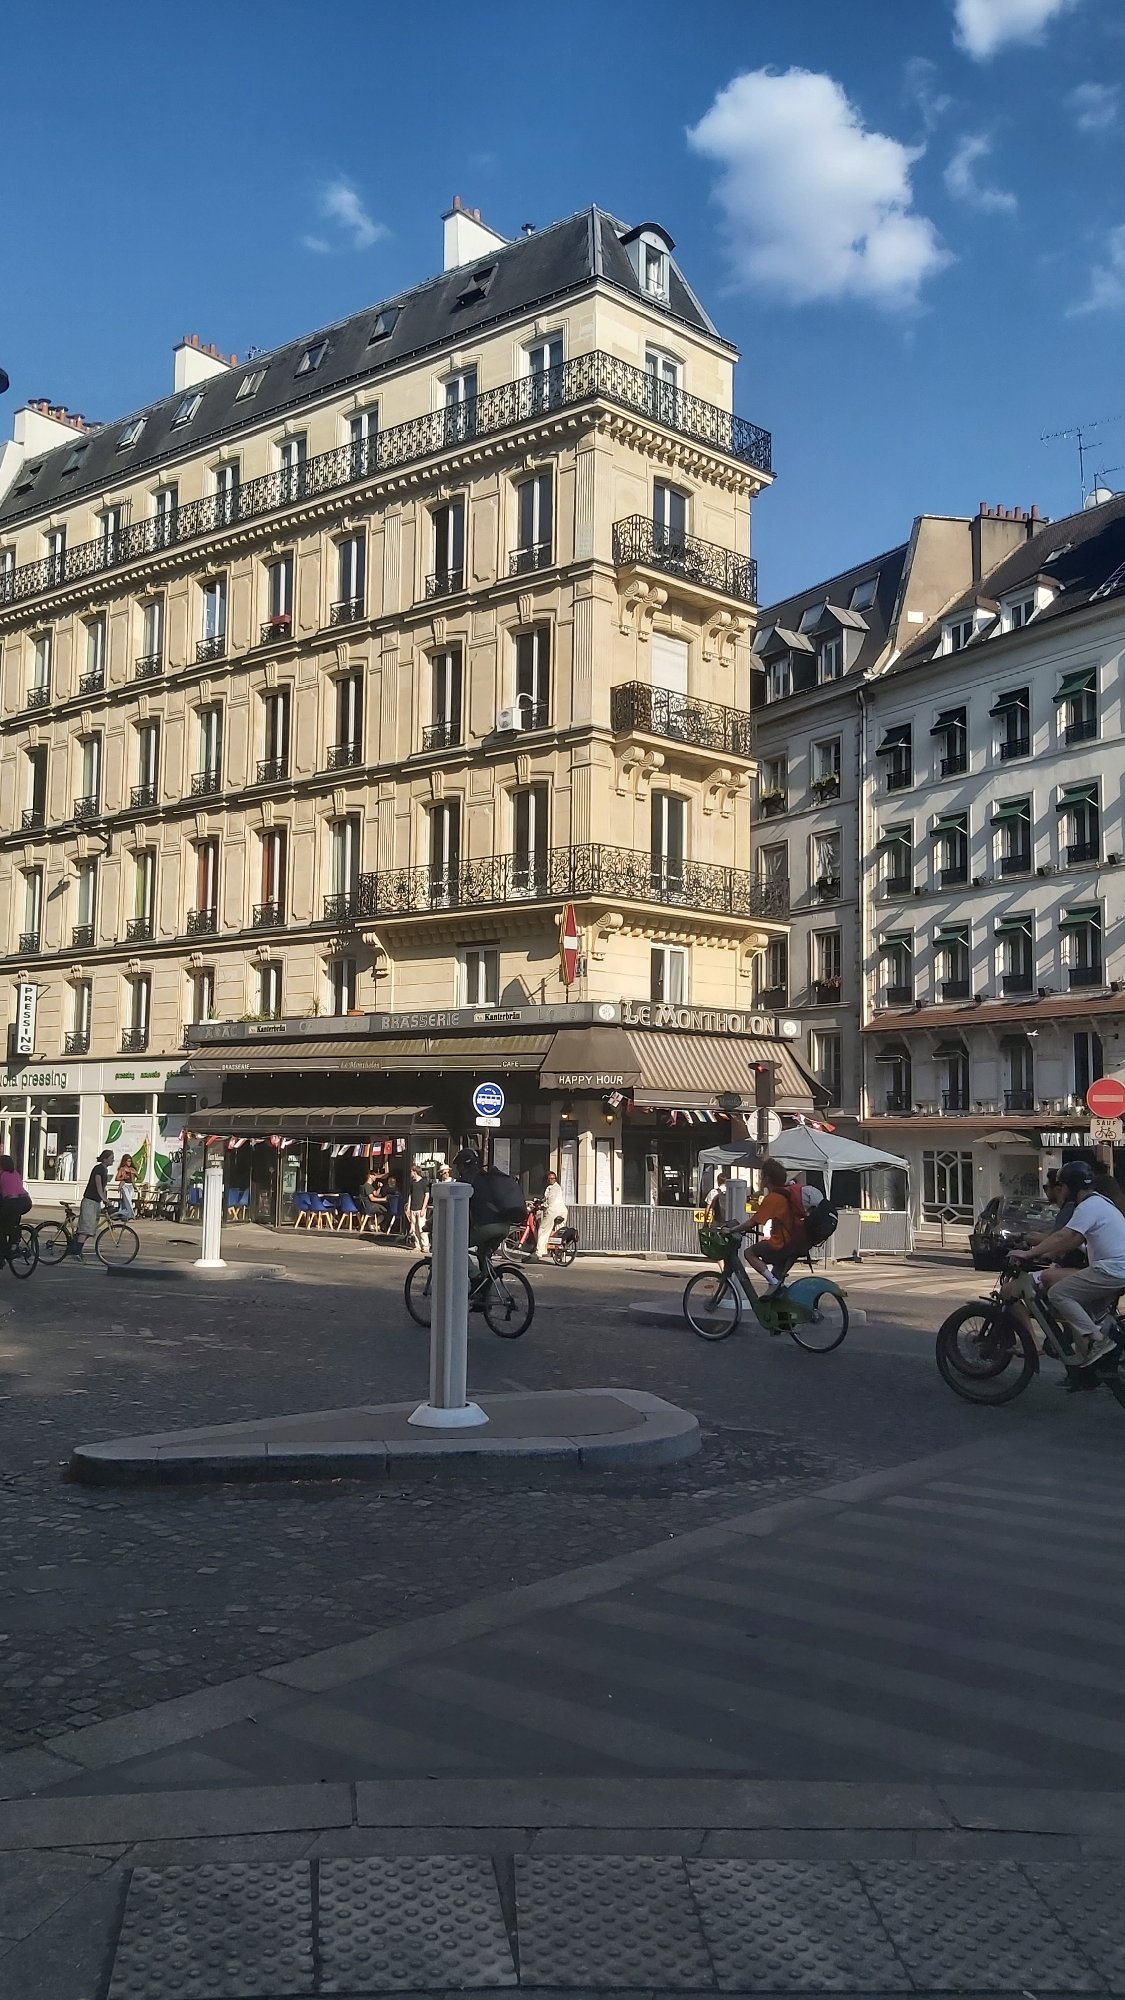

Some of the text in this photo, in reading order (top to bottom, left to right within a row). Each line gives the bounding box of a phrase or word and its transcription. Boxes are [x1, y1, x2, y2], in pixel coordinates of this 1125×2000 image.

[20, 987, 33, 1052] PRESSING
[381, 1012, 460, 1030] BRASSERIE
[624, 1001, 775, 1036] LE MONTHOLON
[21, 1069, 67, 1090] pressing
[559, 1074, 623, 1085] HAPPY HOUR
[1040, 1132, 1080, 1147] VILLA
